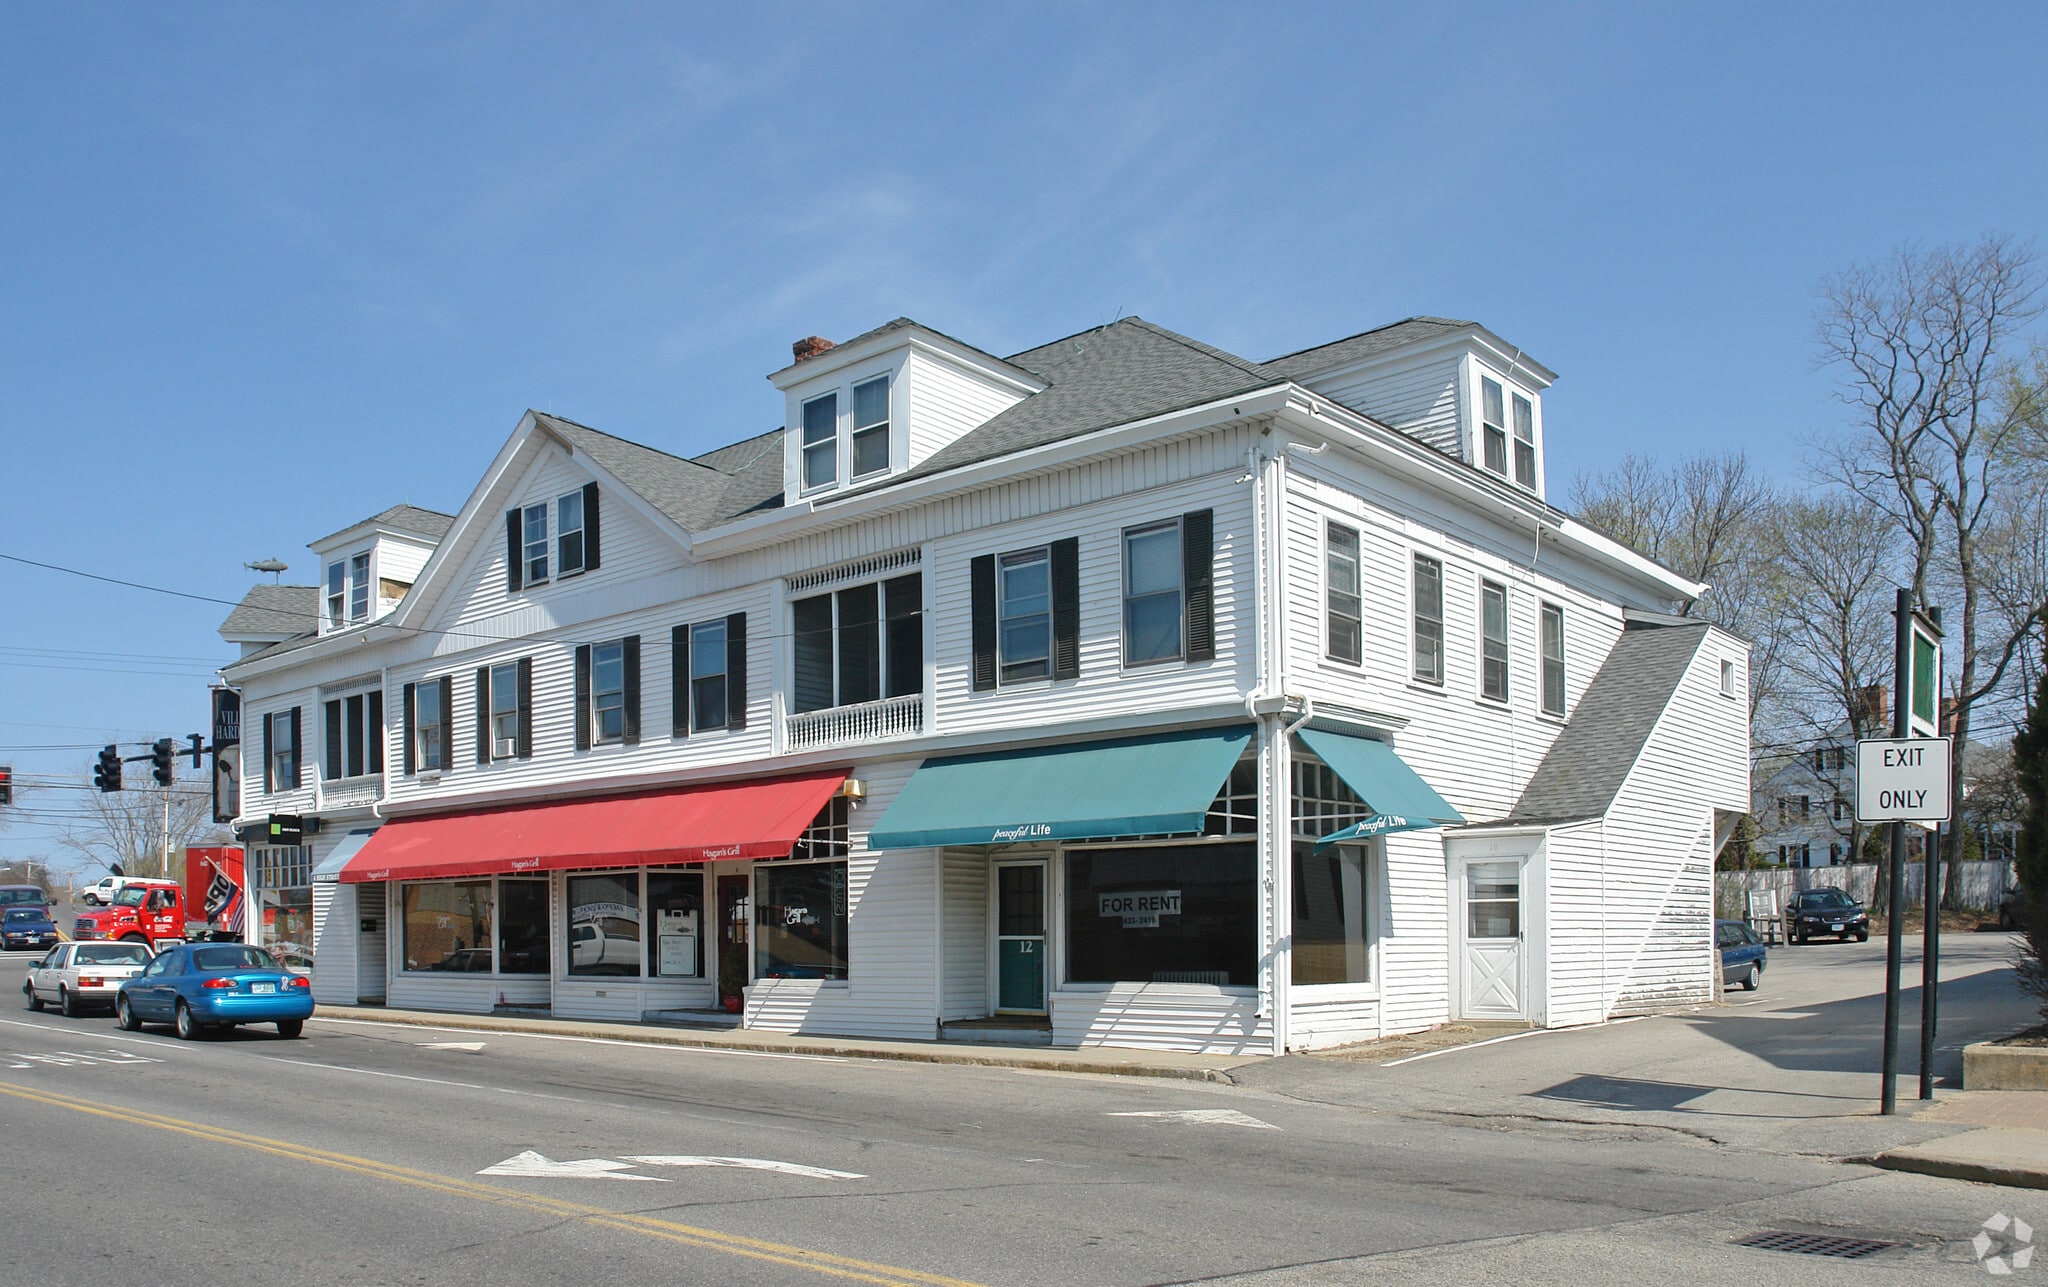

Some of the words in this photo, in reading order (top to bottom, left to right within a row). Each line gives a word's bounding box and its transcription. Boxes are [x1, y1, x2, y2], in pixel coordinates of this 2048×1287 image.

[216, 724, 239, 739] HARD
[1884, 748, 1925, 767] EXIT
[1880, 789, 1928, 809] ONLY
[1388, 815, 1407, 827] Life
[991, 825, 1029, 841] peaceful
[1030, 824, 1051, 836] Life
[702, 848, 727, 860] Hagan's
[727, 844, 740, 856] Grill
[205, 874, 229, 912] OPE
[1102, 898, 1133, 913] FOR
[1138, 896, 1180, 911] RENT
[1019, 940, 1033, 953] 12
